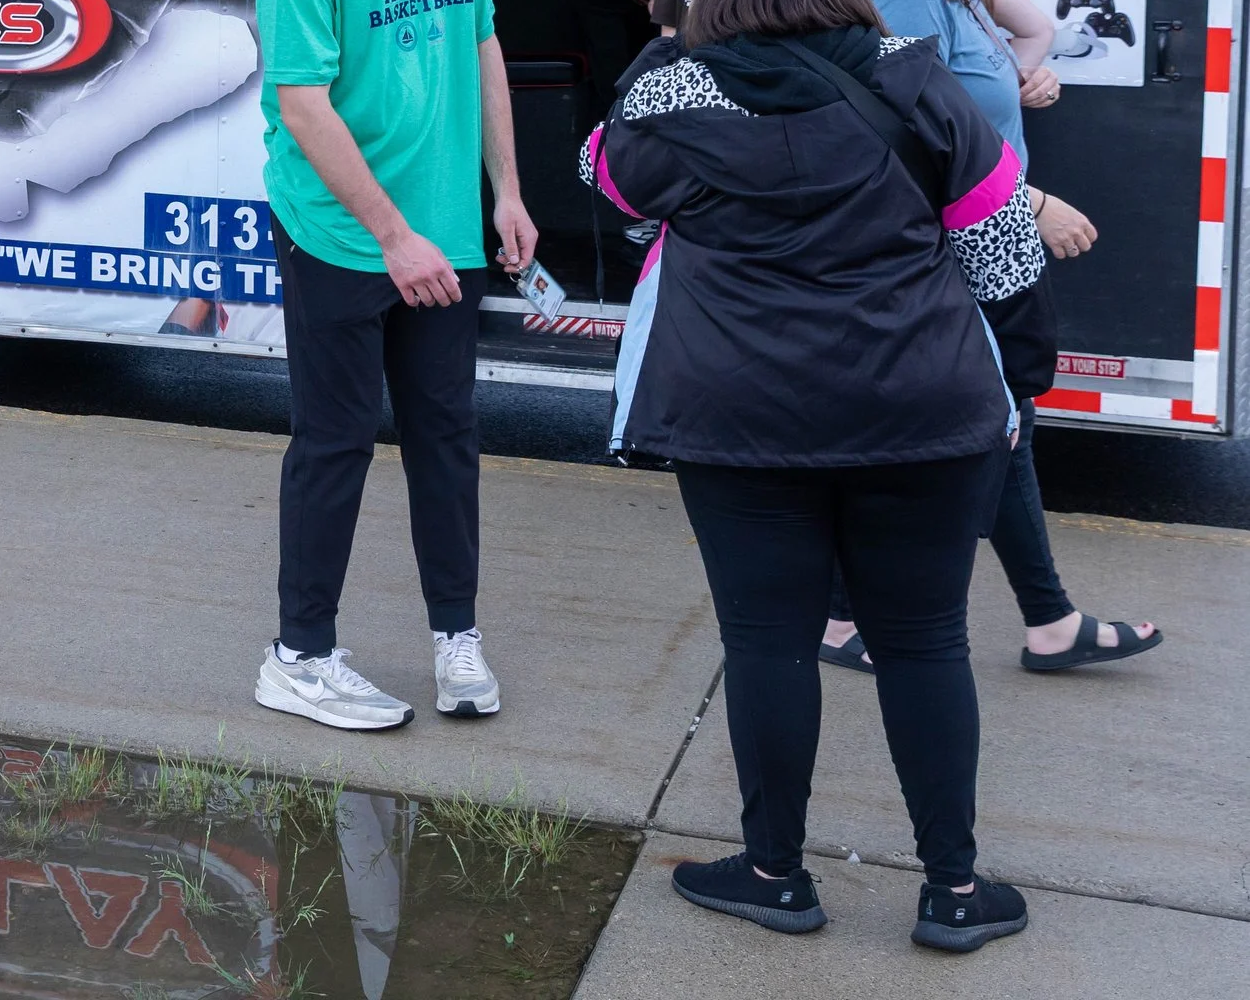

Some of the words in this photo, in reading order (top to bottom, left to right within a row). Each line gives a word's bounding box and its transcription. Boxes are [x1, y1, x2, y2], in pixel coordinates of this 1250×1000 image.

[90, 252, 222, 292] BRING
[595, 322, 622, 338] WATCH
[1071, 358, 1097, 374] YOUR
[1097, 360, 1122, 376] STEP
